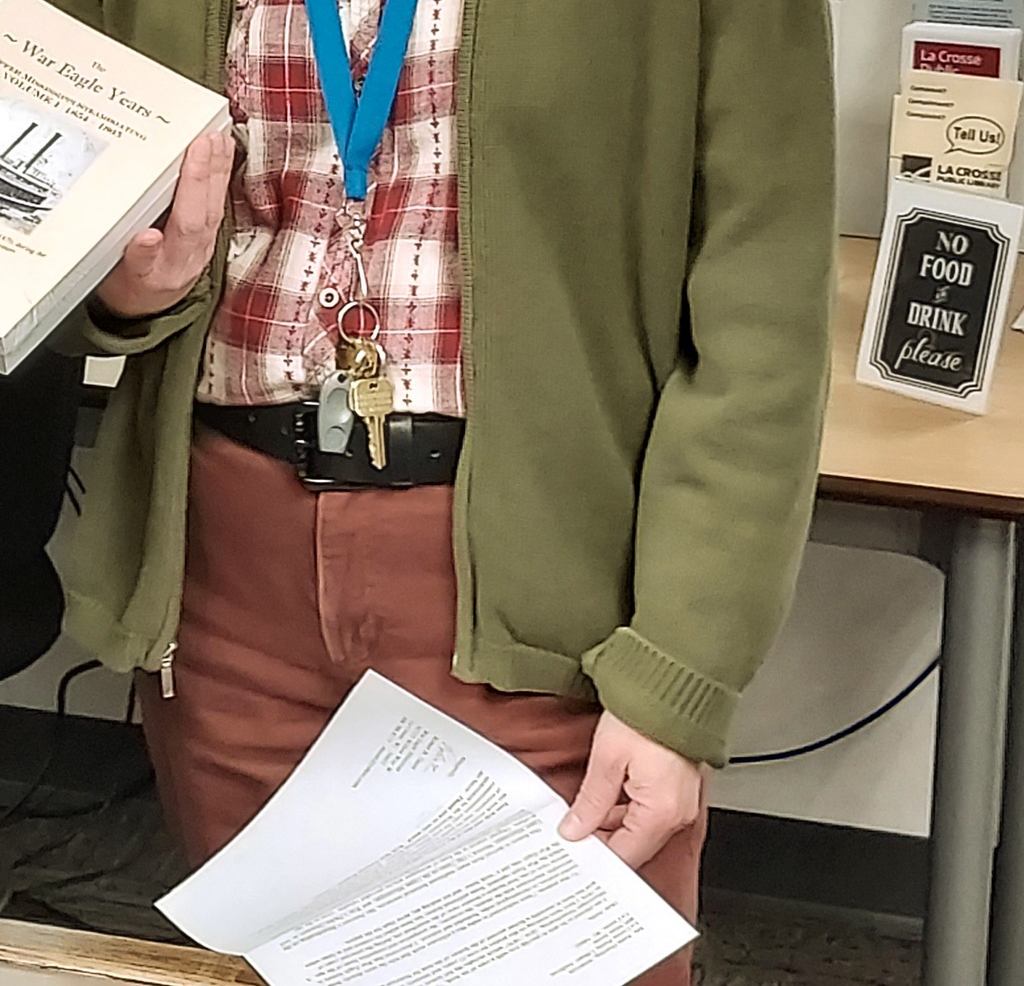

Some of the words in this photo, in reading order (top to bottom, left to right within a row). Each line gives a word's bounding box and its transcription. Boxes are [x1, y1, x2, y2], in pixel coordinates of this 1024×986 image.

[920, 49, 936, 61] La
[938, 50, 982, 66] Crosse
[3, 72, 51, 104] VOLUME
[22, 40, 56, 68] War
[56, 63, 103, 93] Eagle
[108, 87, 152, 118] Years
[954, 126, 974, 140] Tell
[979, 130, 1001, 144] Us!
[936, 176, 966, 185] PUBLIC
[938, 165, 954, 175] LA
[956, 168, 1002, 182] CROSSE
[936, 230, 970, 255] NO
[920, 255, 974, 286] FOOD
[907, 302, 968, 336] DRINK
[895, 336, 963, 371] please
